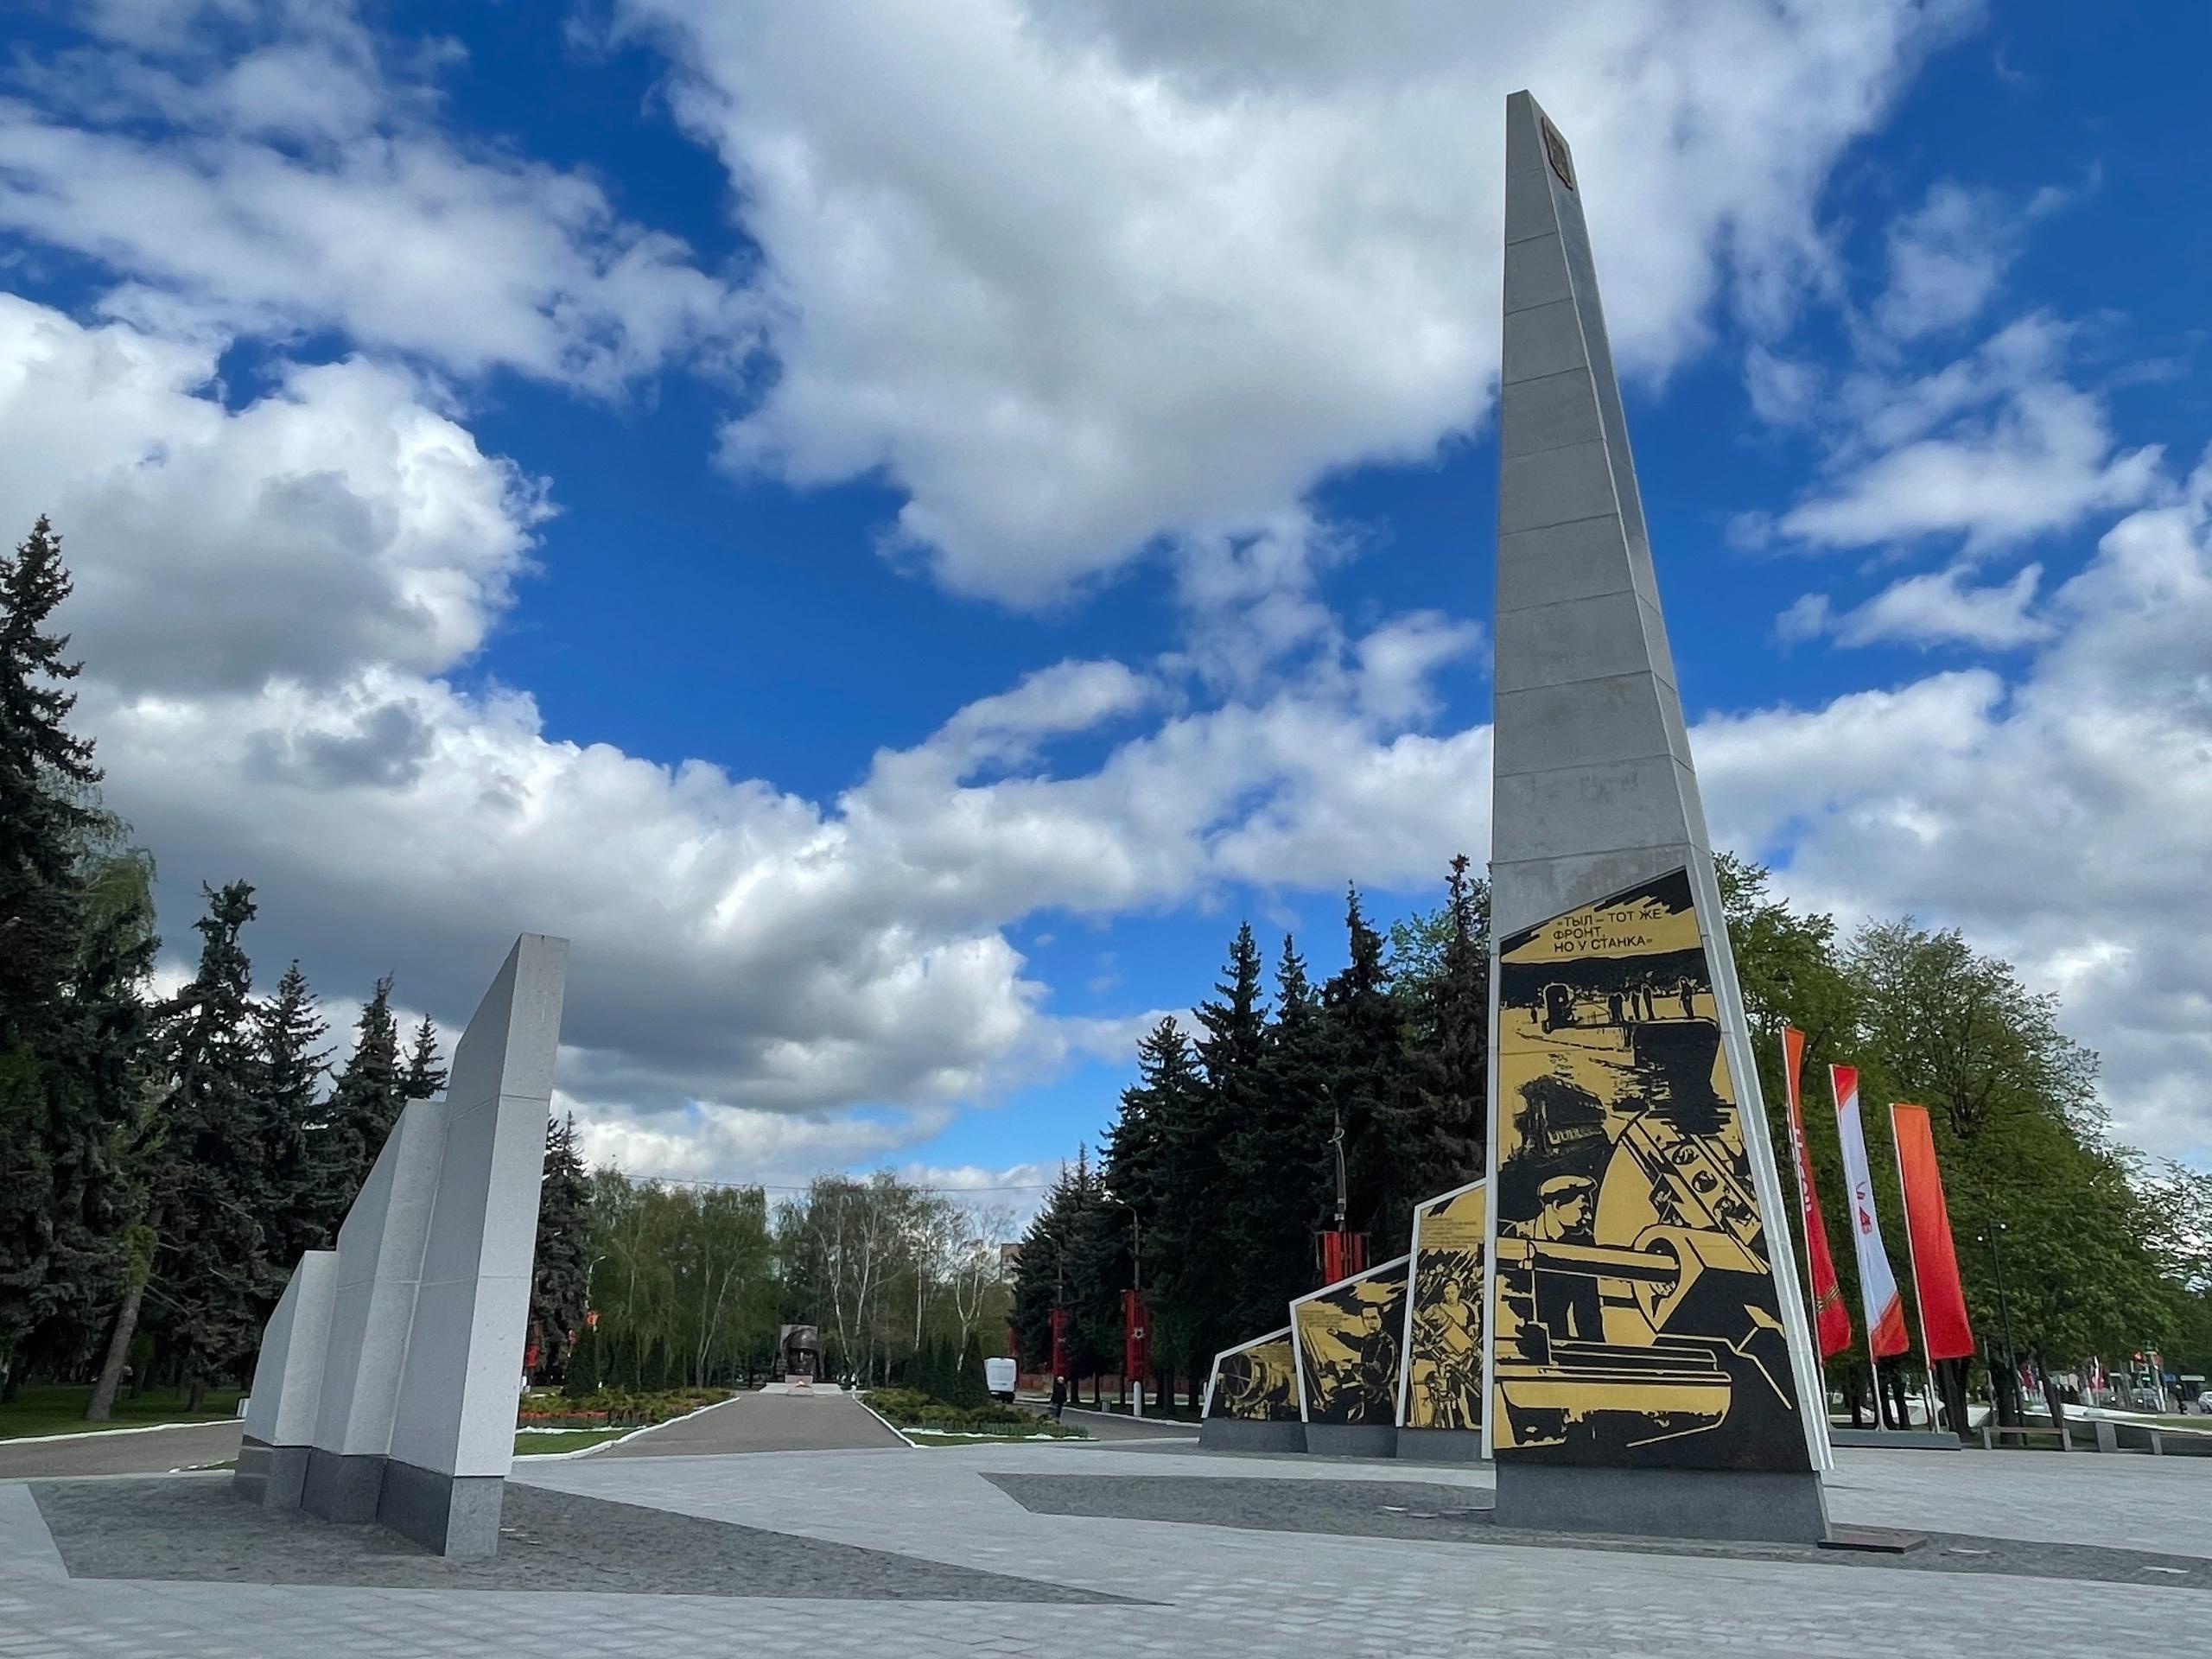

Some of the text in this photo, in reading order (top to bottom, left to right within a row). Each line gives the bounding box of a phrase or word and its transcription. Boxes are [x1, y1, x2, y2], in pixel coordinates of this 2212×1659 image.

[1607, 911, 1634, 923] ТОТ
[1639, 908, 1662, 920] ЖЕ
[1553, 926, 1605, 939] ФРОНТ,
[1554, 941, 1574, 953] НО
[1579, 940, 1587, 951] У
